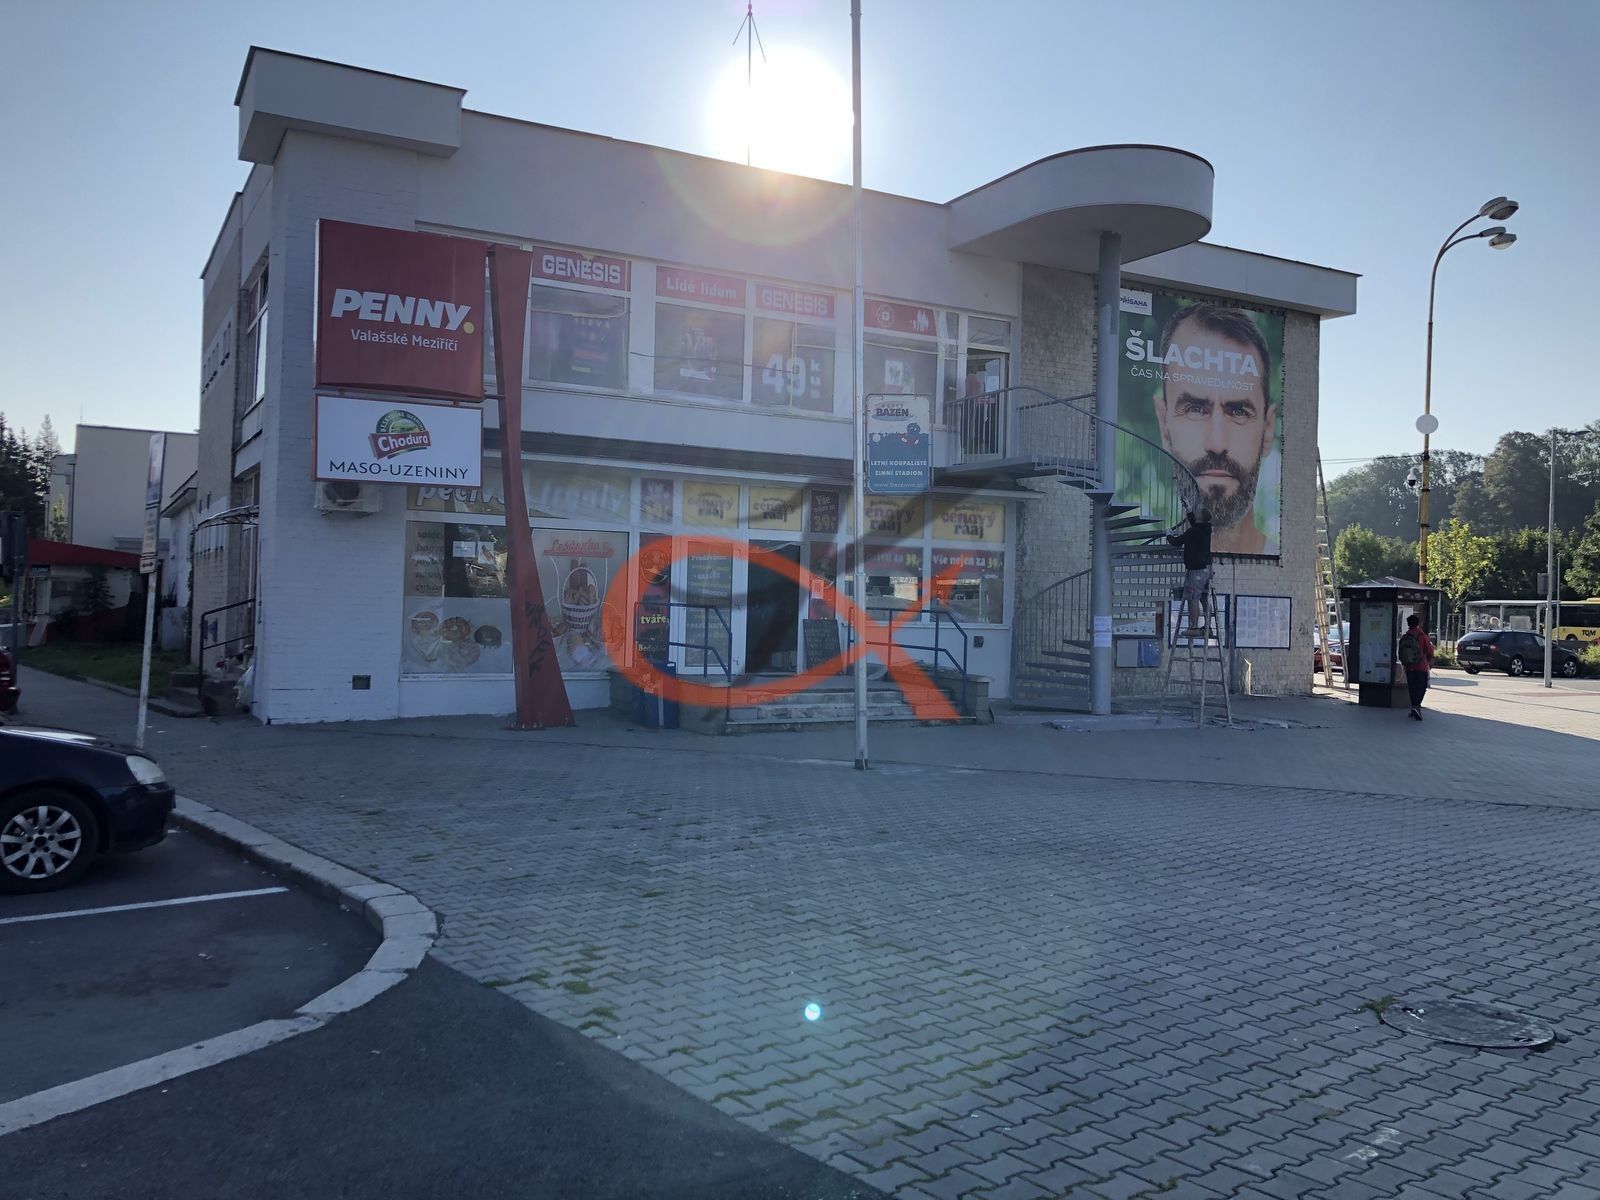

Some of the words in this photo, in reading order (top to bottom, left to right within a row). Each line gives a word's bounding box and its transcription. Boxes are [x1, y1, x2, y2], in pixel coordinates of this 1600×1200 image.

[542, 254, 621, 284] GENESIS
[762, 287, 828, 315] GENESIS
[351, 328, 408, 345] Valašské
[411, 335, 459, 352] Meziříčí
[1125, 329, 1259, 377] ŠLACHTA
[1130, 365, 1153, 379] ČAS
[1155, 370, 1171, 381] NA
[1172, 372, 1255, 392] SPRAVEDLNOST
[378, 434, 429, 452] Chodura
[329, 460, 469, 479] MASO-UZENINY
[941, 511, 996, 528] cenový
[954, 522, 984, 539] raaj
[949, 554, 974, 567] nejen
[975, 557, 985, 566] za
